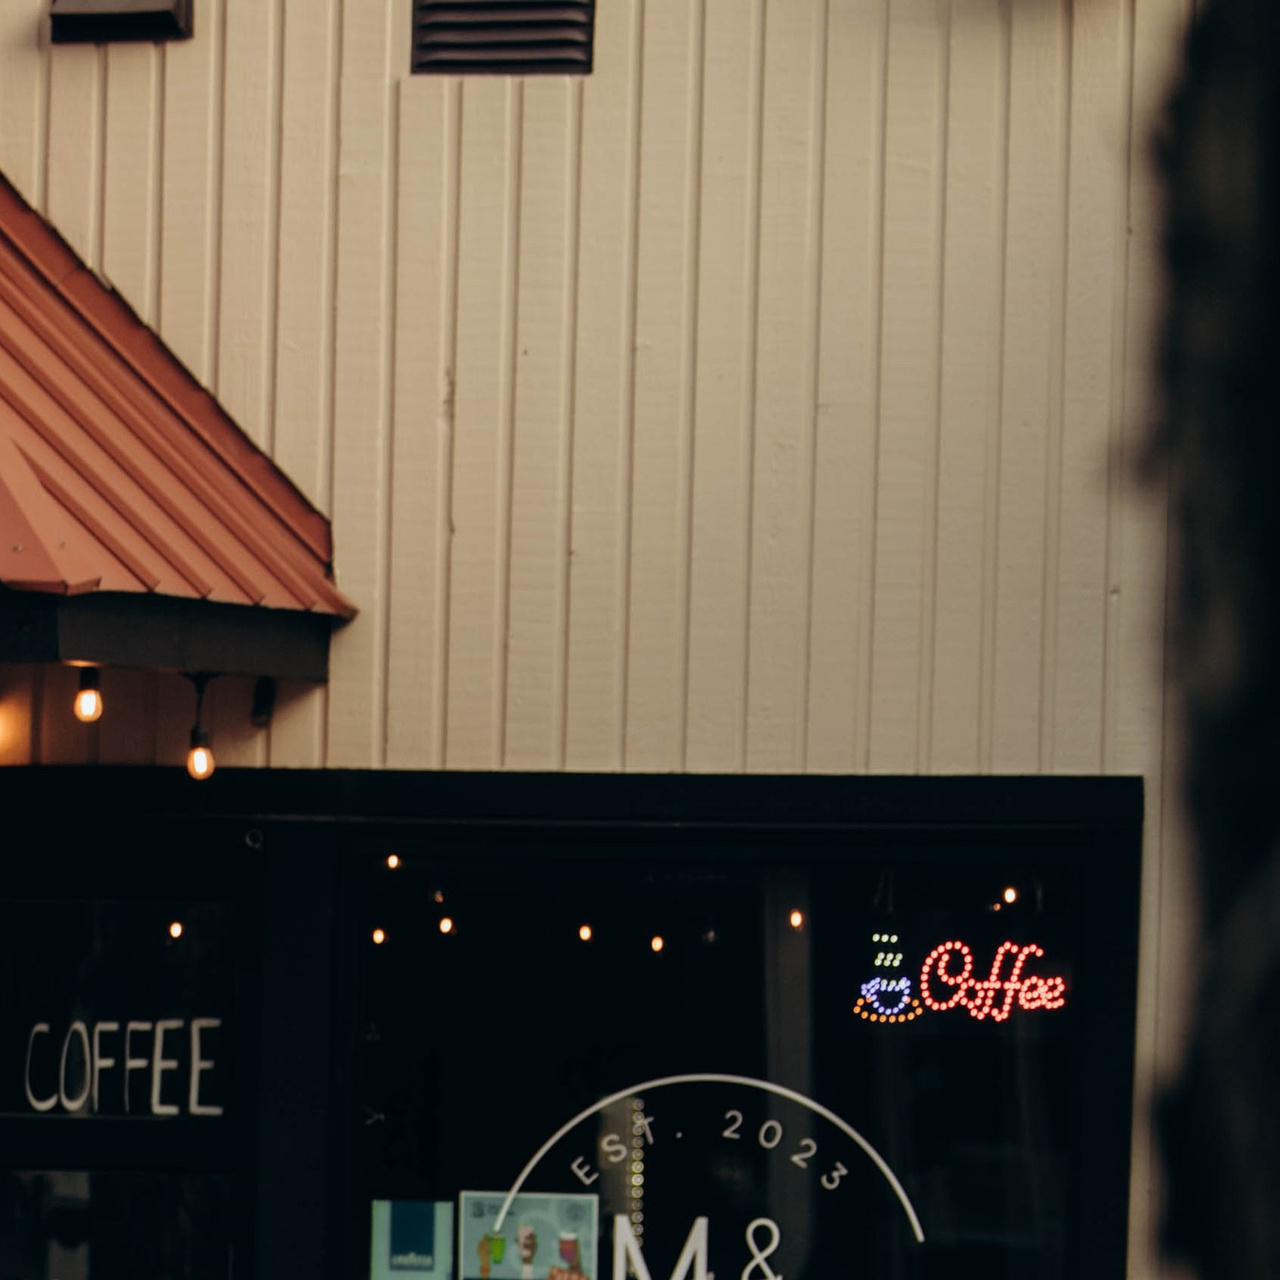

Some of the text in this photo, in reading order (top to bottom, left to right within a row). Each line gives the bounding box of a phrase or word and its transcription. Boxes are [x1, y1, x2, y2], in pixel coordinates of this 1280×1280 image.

[920, 940, 1066, 1022] Coffee
[24, 1017, 223, 1116] COFFEE
[722, 1109, 849, 1191] 2023
